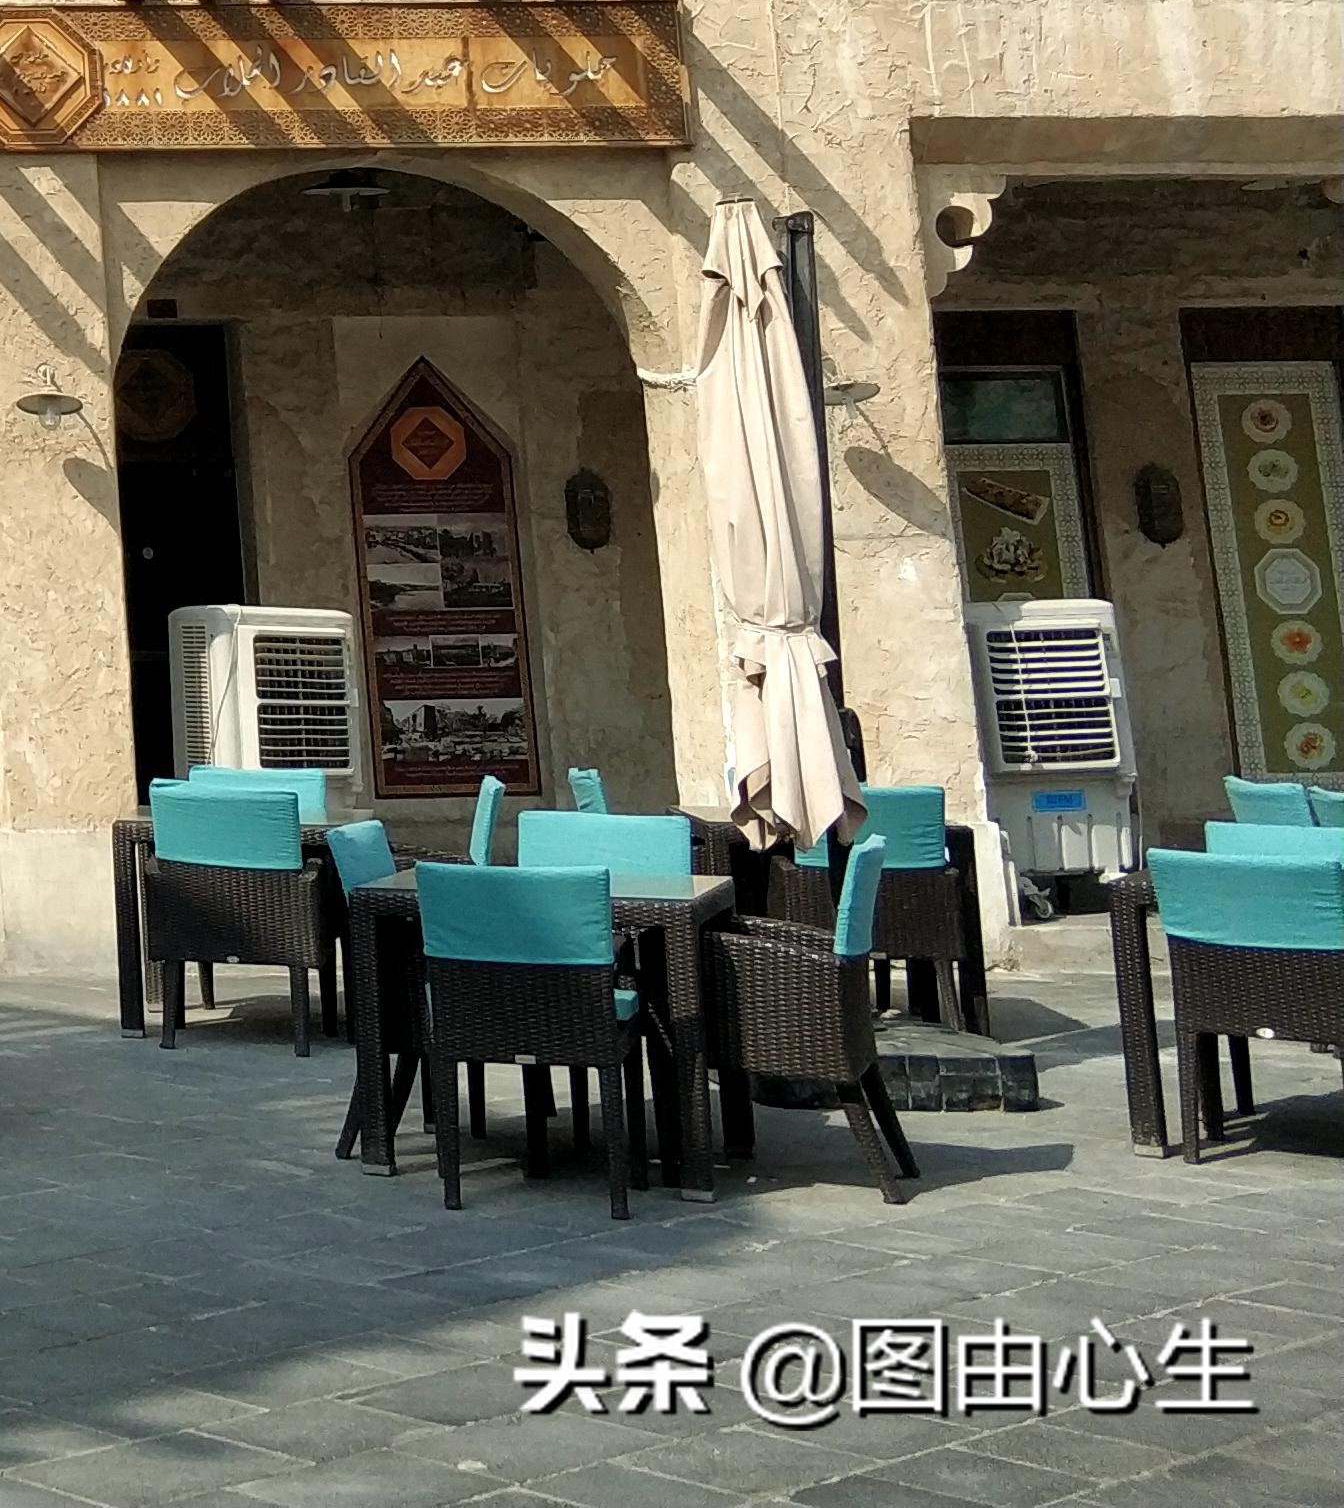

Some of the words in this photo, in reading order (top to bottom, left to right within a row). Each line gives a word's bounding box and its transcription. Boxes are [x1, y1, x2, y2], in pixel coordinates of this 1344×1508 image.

[173, 44, 282, 103] الحلاب
[290, 47, 403, 96] القادر
[401, 53, 468, 95] عبد
[480, 50, 618, 98] حلويات
